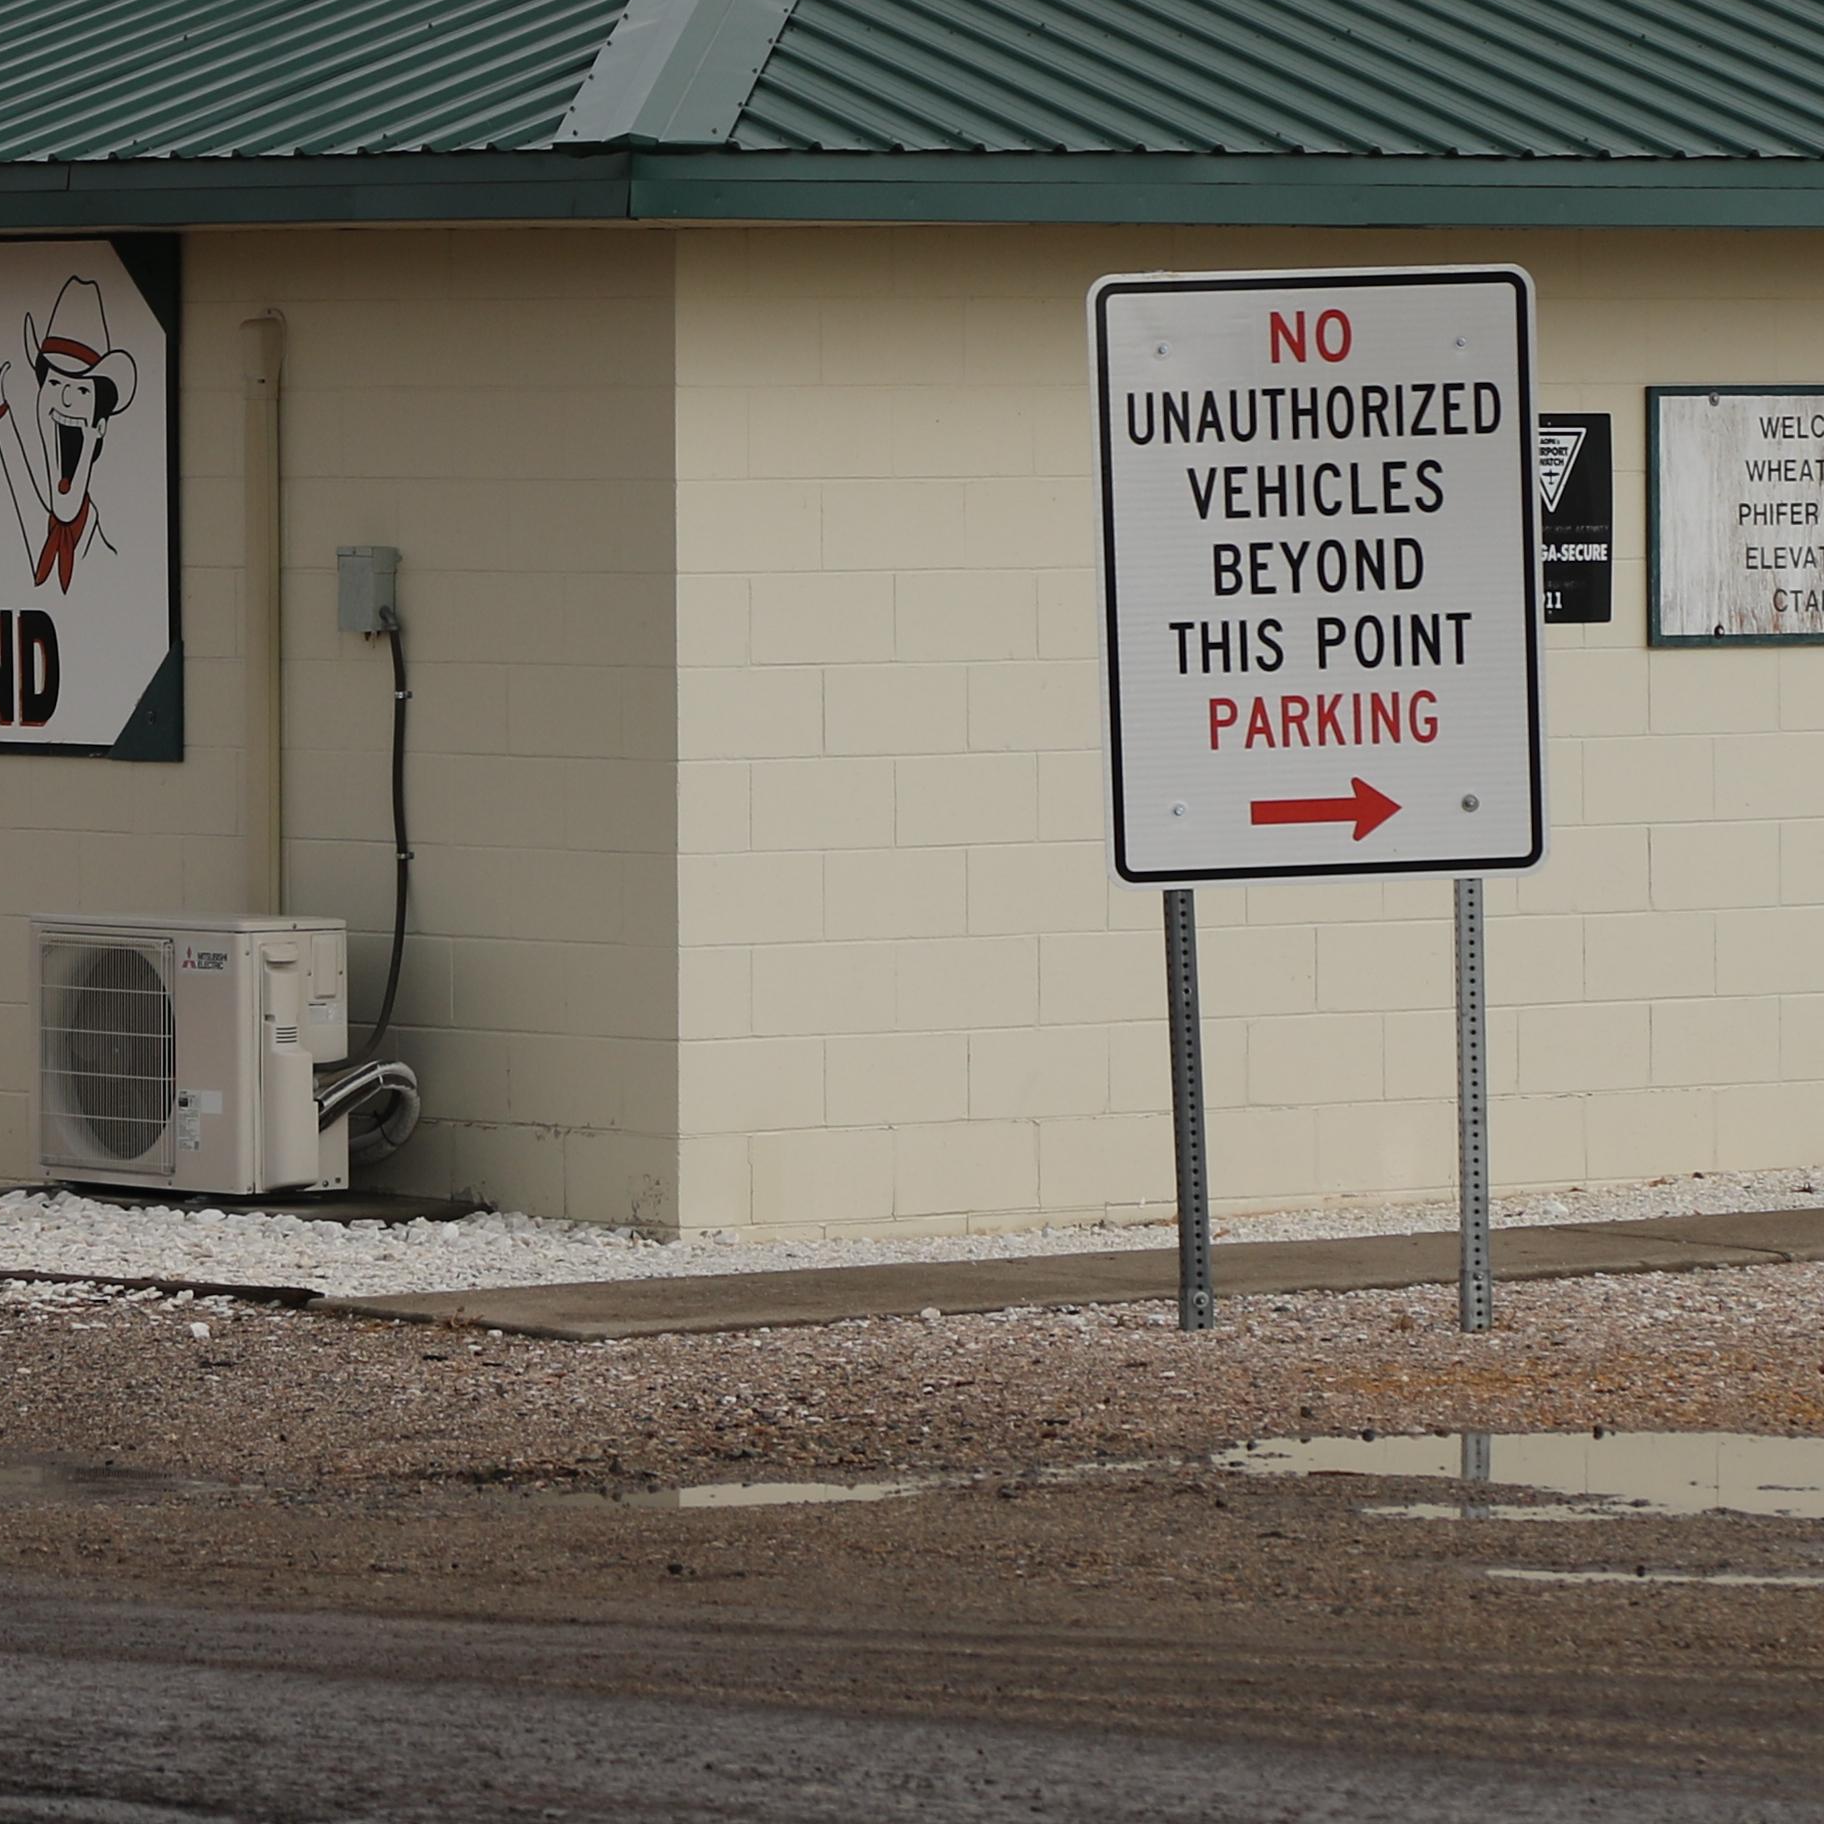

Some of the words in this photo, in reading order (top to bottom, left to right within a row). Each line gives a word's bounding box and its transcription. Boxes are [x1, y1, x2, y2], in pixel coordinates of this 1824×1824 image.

[1268, 308, 1352, 364] NO
[1126, 380, 1502, 445] UNAUTHORIZED
[1539, 446, 1568, 457] RPORT
[1187, 460, 1444, 520] VEHICLES
[1738, 503, 1819, 525] PHIFER
[1213, 538, 1423, 596] BEYOND
[1543, 591, 1563, 610] 11
[1169, 619, 1284, 674] THIS
[1318, 612, 1472, 669] POINT
[1209, 690, 1439, 751] PARKING
